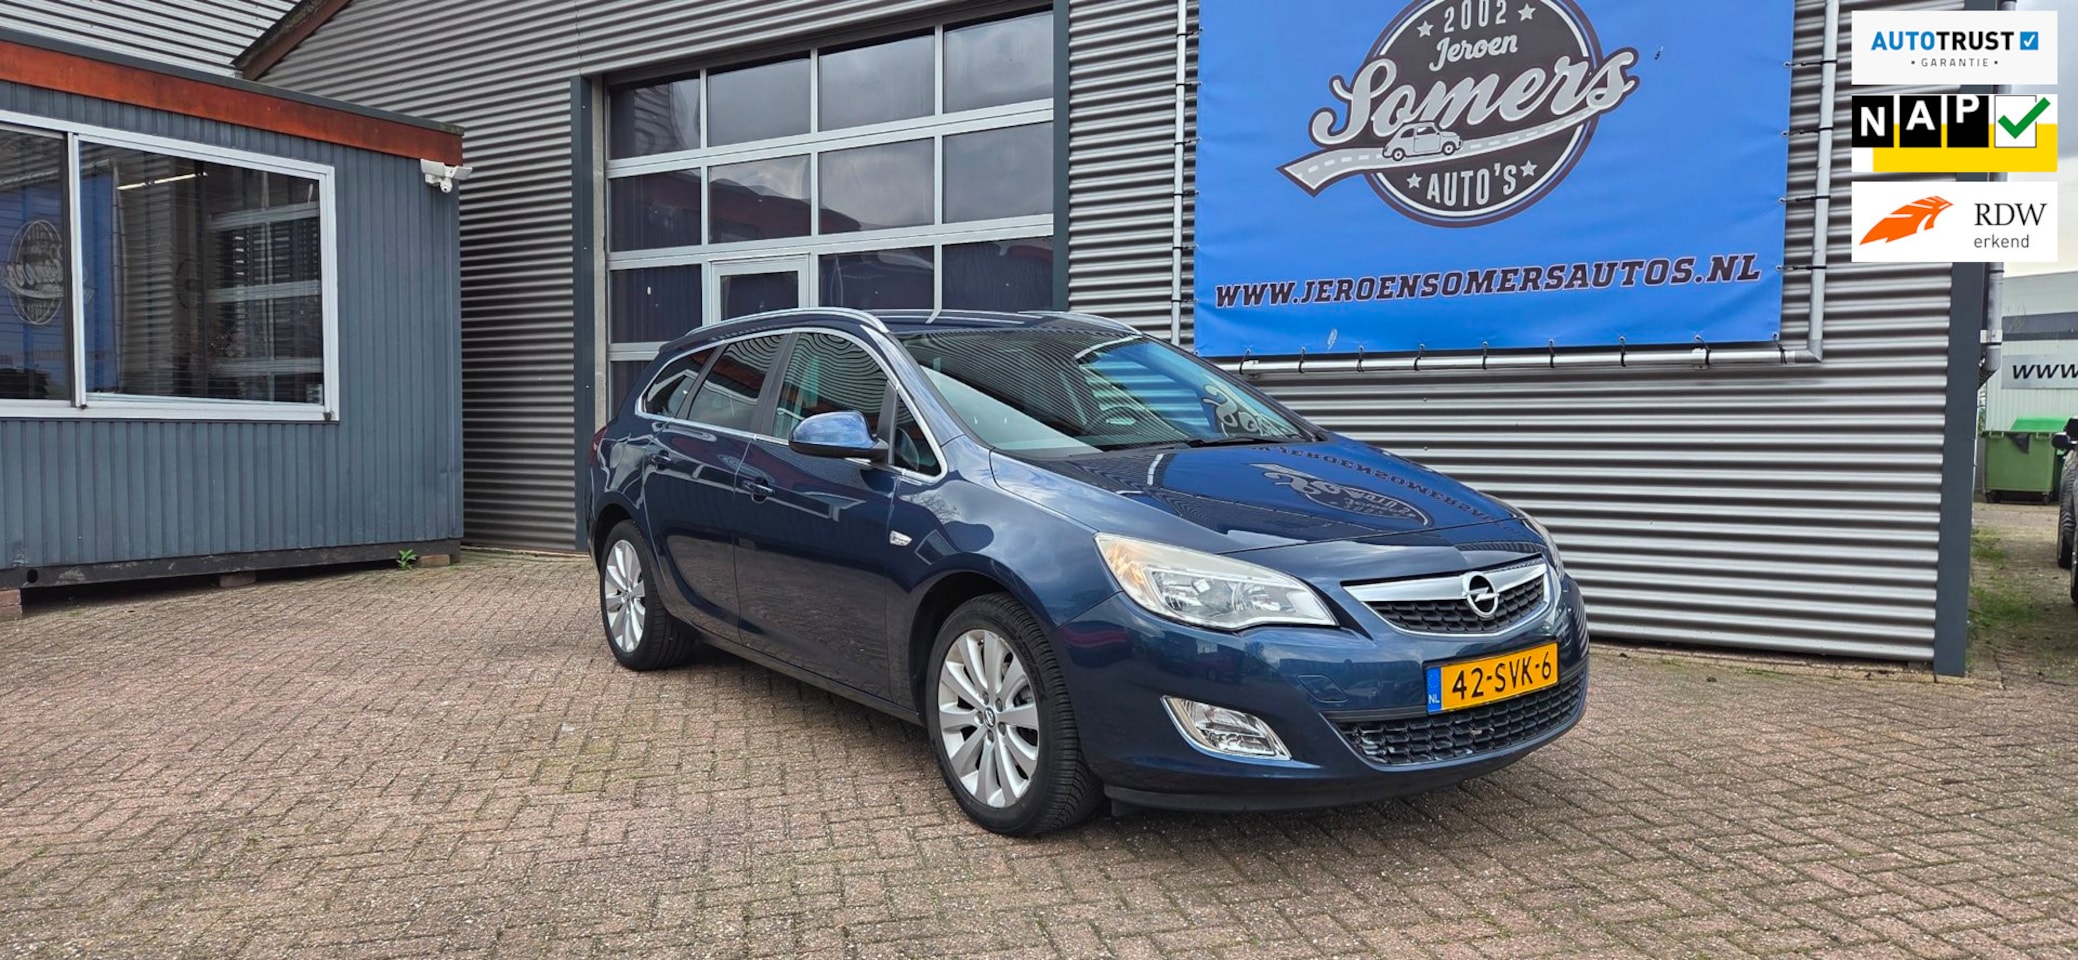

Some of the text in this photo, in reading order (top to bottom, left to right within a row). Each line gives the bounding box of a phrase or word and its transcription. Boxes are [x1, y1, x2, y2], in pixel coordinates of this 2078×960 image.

[1444, 0, 1507, 33] 2002
[1429, 34, 1518, 71] Jeroen
[1311, 51, 1636, 145] Somers
[1426, 162, 1518, 207] AUTO'S
[1215, 254, 1761, 308] WWW.JEROENSOMERSAUTOS.NL
[1452, 651, 1552, 700] 42-SVK-6
[1428, 693, 1440, 705] NL
